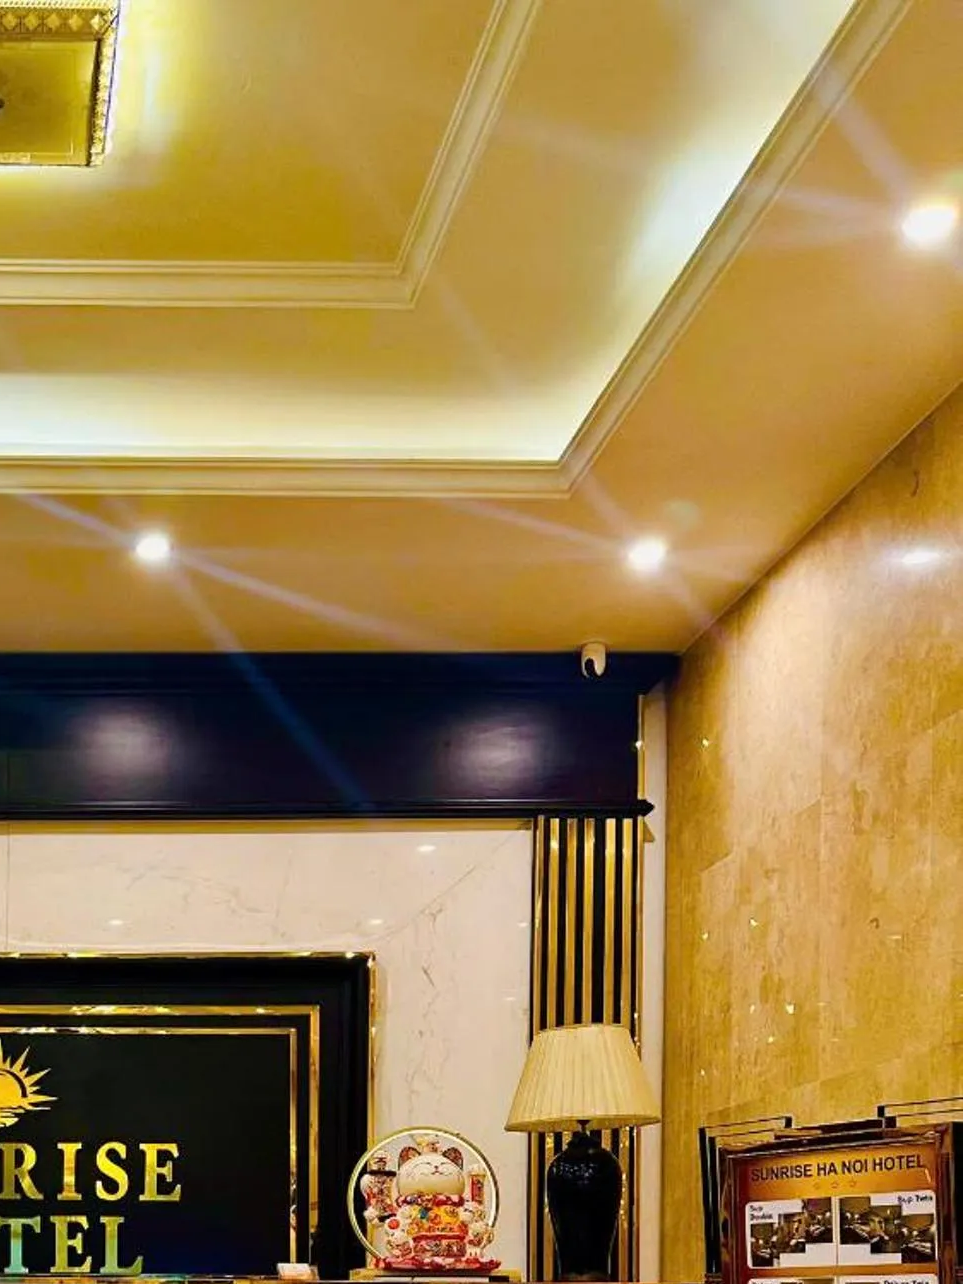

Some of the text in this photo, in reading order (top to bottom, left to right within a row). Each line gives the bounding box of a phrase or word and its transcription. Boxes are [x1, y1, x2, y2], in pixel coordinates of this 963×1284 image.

[751, 1154, 925, 1182] SUNRISE HA NOI HOTEL
